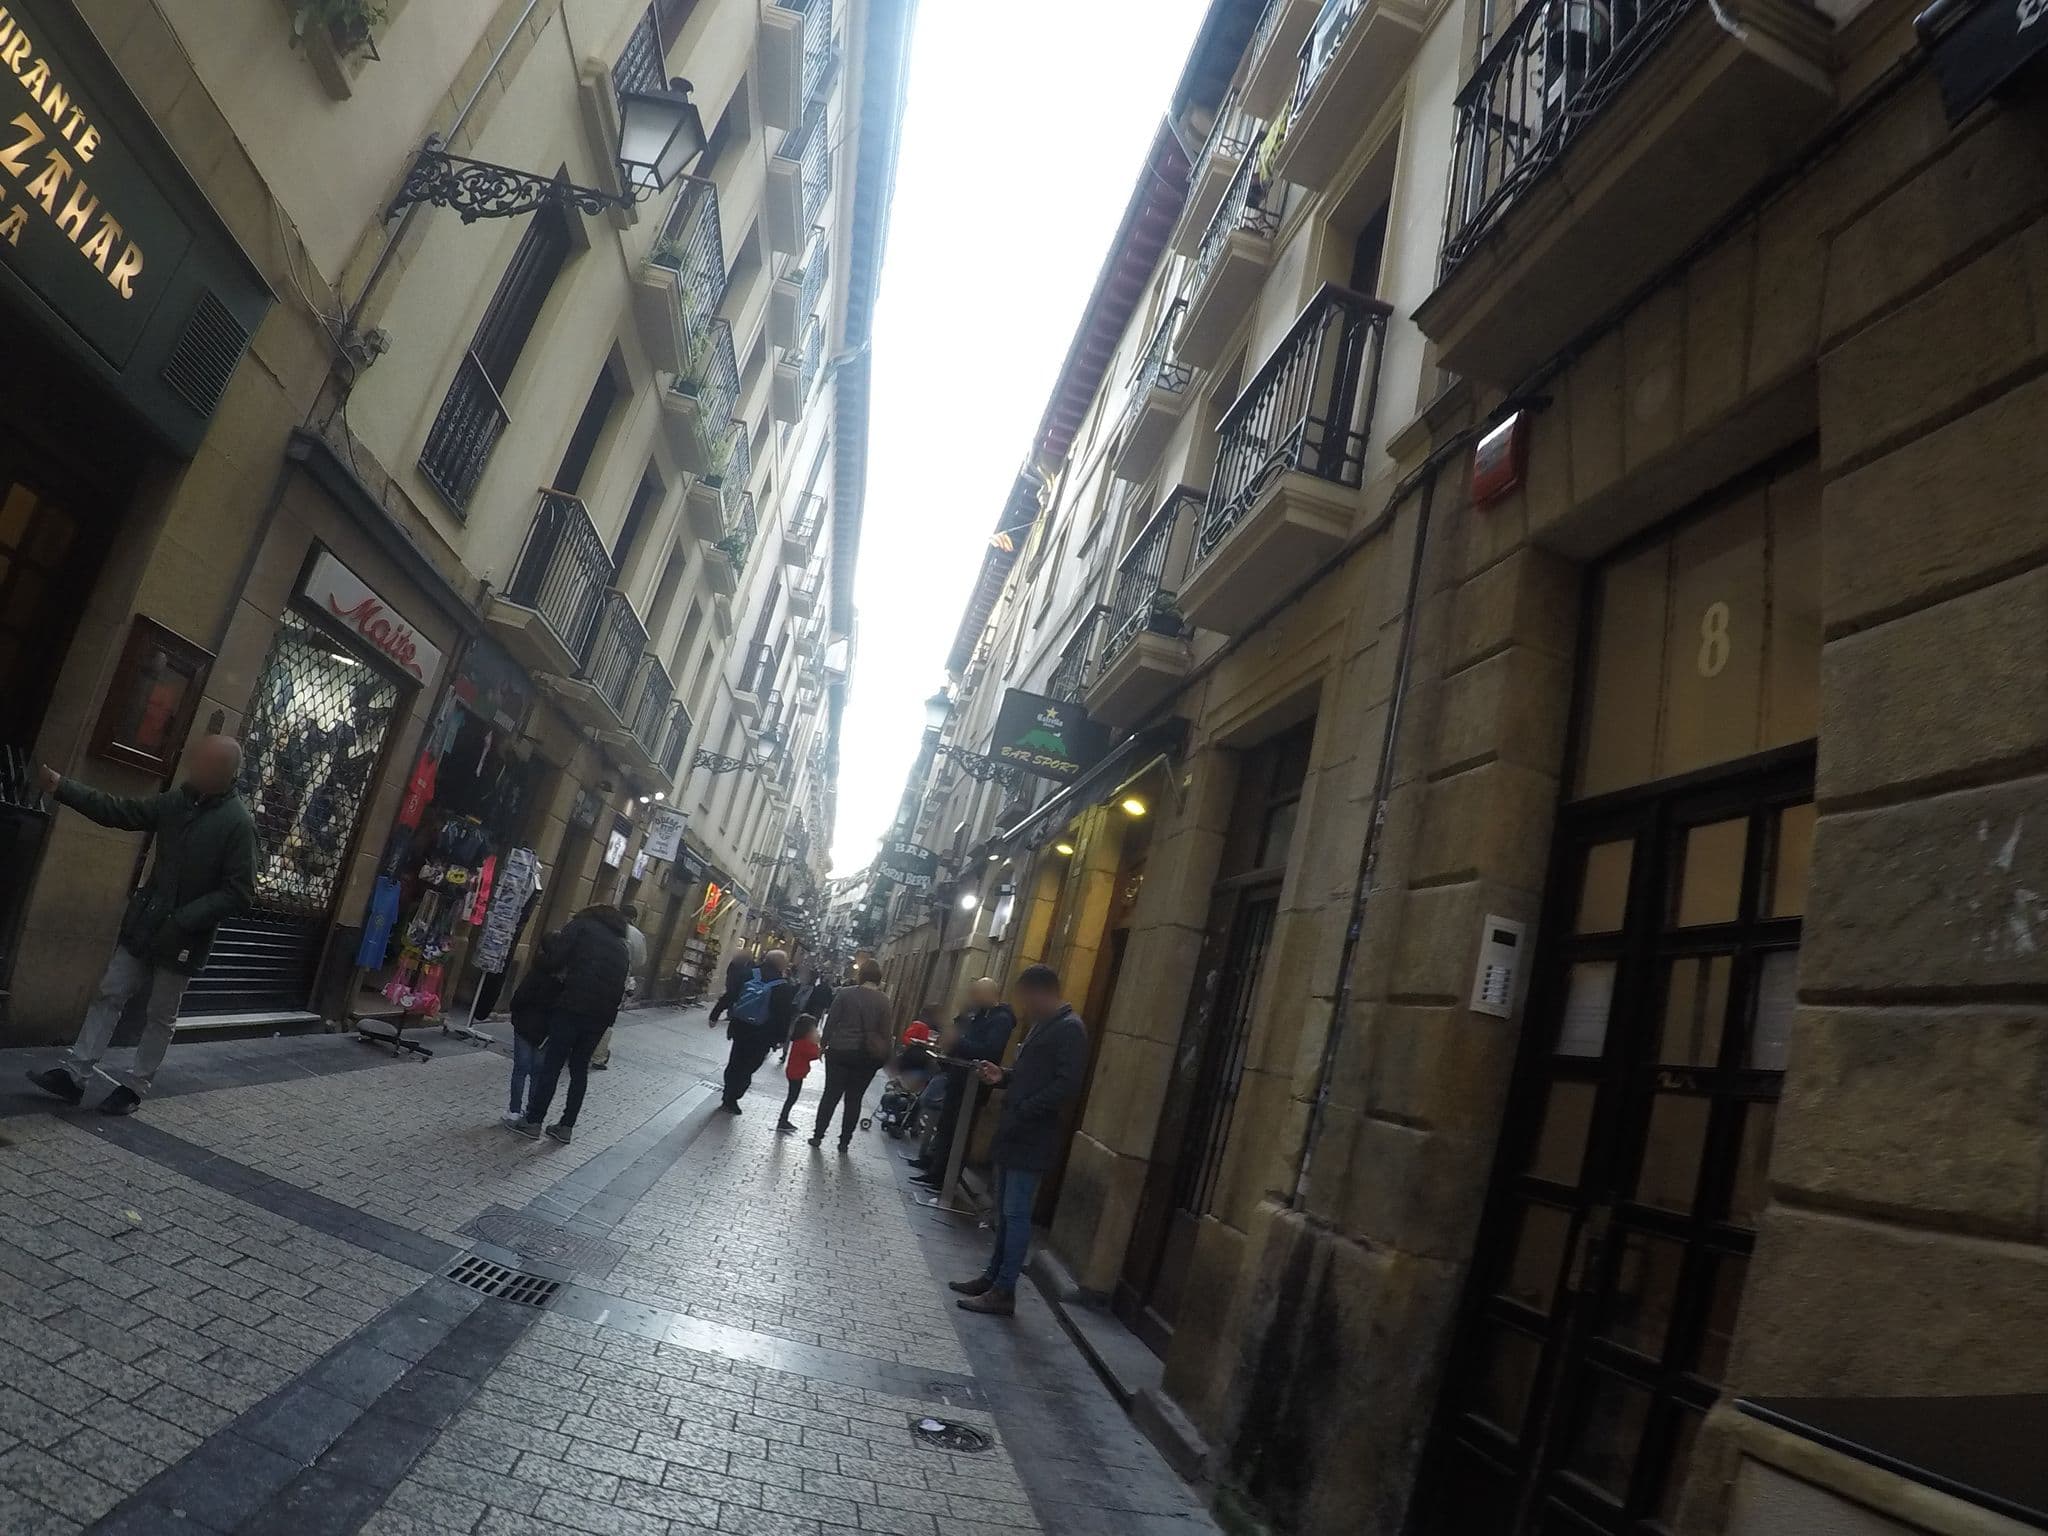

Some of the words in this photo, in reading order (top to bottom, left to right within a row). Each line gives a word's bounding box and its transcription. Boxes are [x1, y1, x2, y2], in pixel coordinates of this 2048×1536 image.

[0, 112, 144, 300] ZAHAR
[329, 592, 423, 679] Maite
[1698, 600, 1730, 678] 8
[1001, 746, 1031, 761] BAR
[1032, 755, 1079, 774] SPORT
[895, 843, 929, 859] BAR
